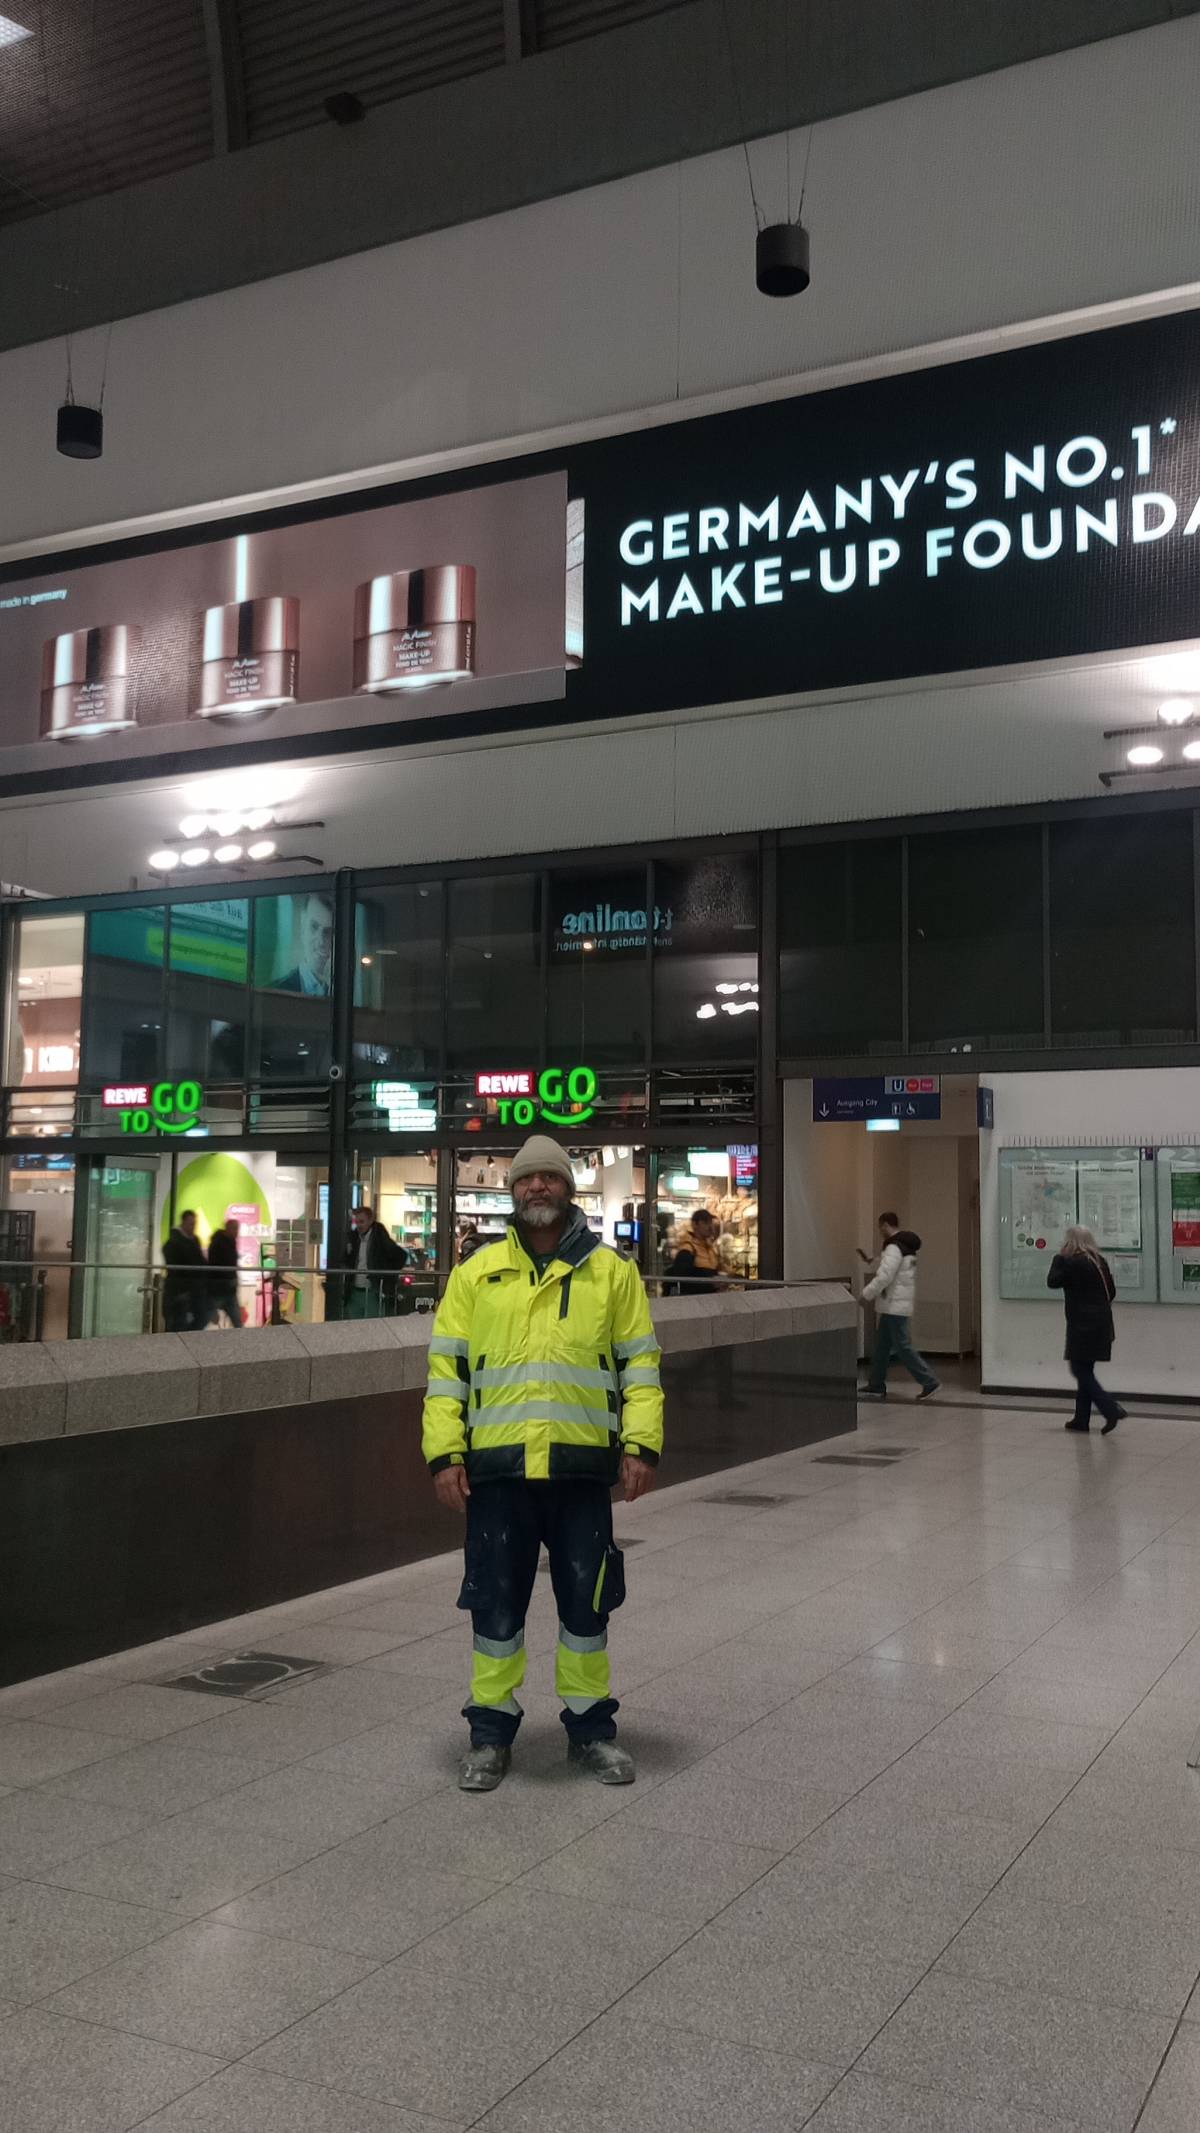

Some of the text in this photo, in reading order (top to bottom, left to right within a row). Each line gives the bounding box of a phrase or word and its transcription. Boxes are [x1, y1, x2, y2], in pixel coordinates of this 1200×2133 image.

[619, 458, 978, 567] GERMANY'S
[620, 539, 901, 627] MAKE-UP
[103, 1080, 202, 1133] REWE TO GO
[476, 1066, 597, 1126] REWE TO GO
[865, 1098, 878, 1108] City
[894, 1079, 904, 1092] U
